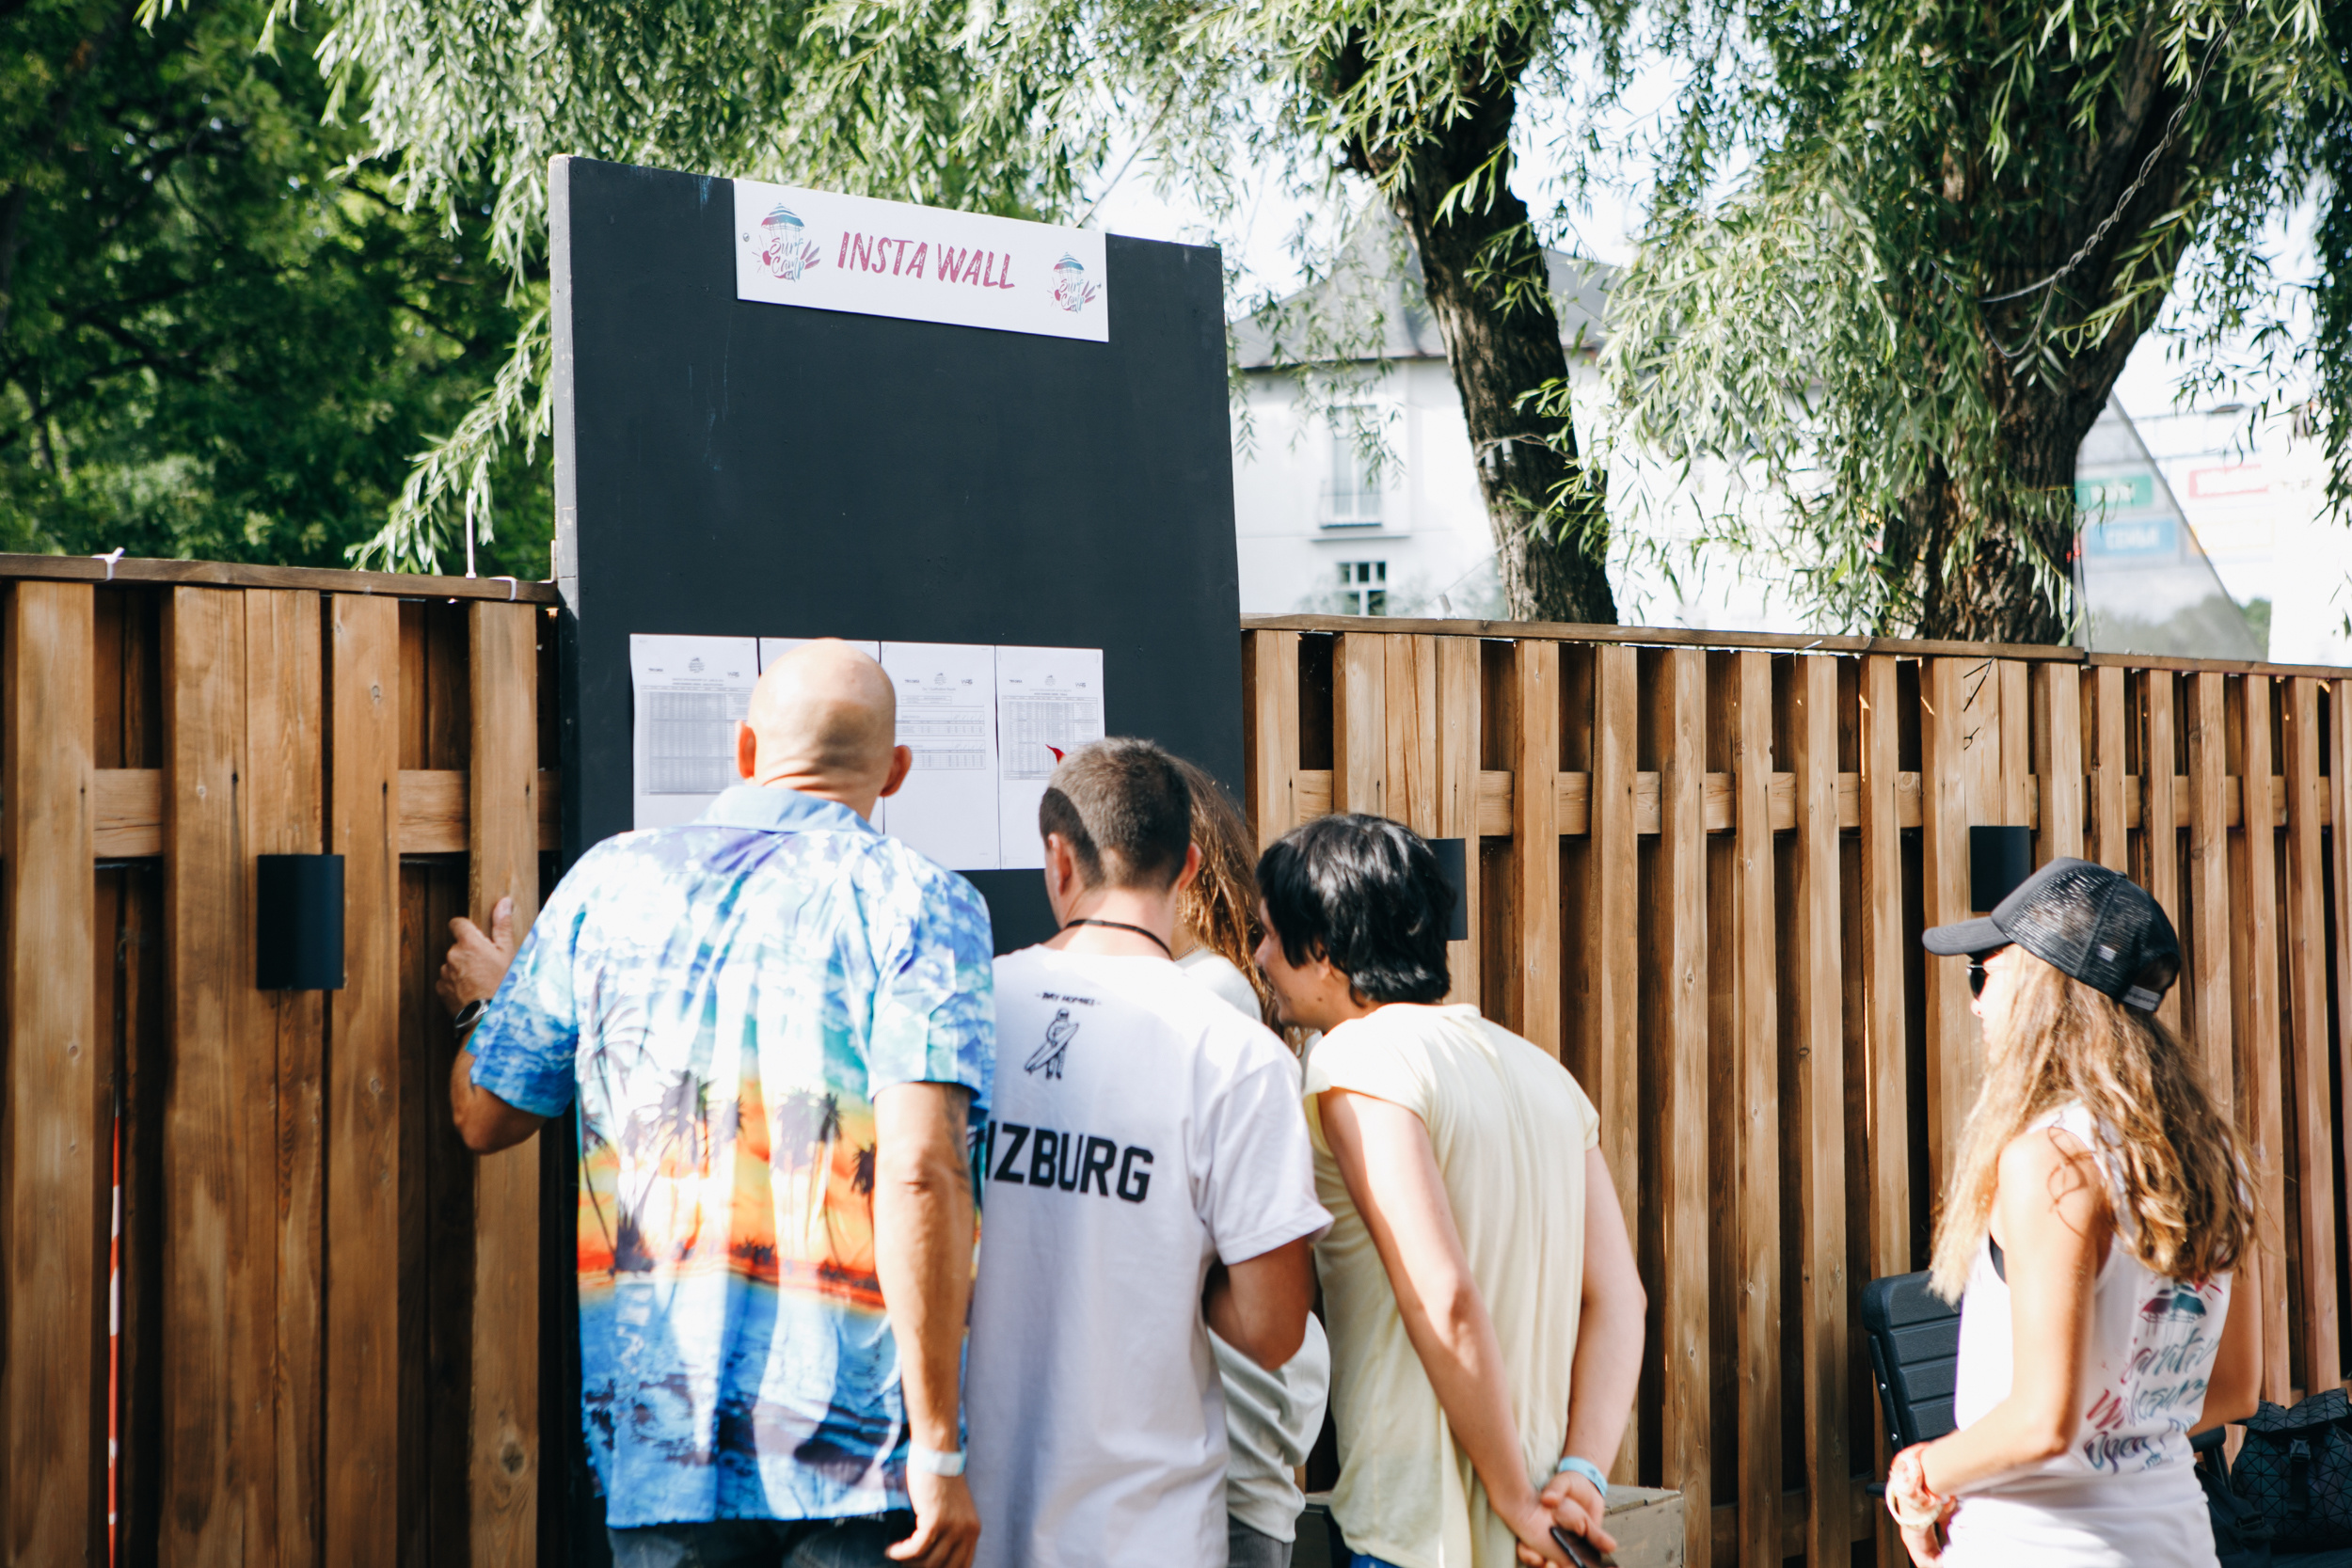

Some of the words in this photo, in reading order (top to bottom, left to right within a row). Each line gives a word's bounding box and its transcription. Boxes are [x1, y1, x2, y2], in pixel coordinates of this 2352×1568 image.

[770, 237, 803, 257] Surf
[771, 255, 805, 280] Camp
[837, 230, 928, 279] INSTA
[938, 242, 1016, 291] WALL
[1059, 278, 1084, 293] Surf
[1061, 293, 1085, 311] Camp
